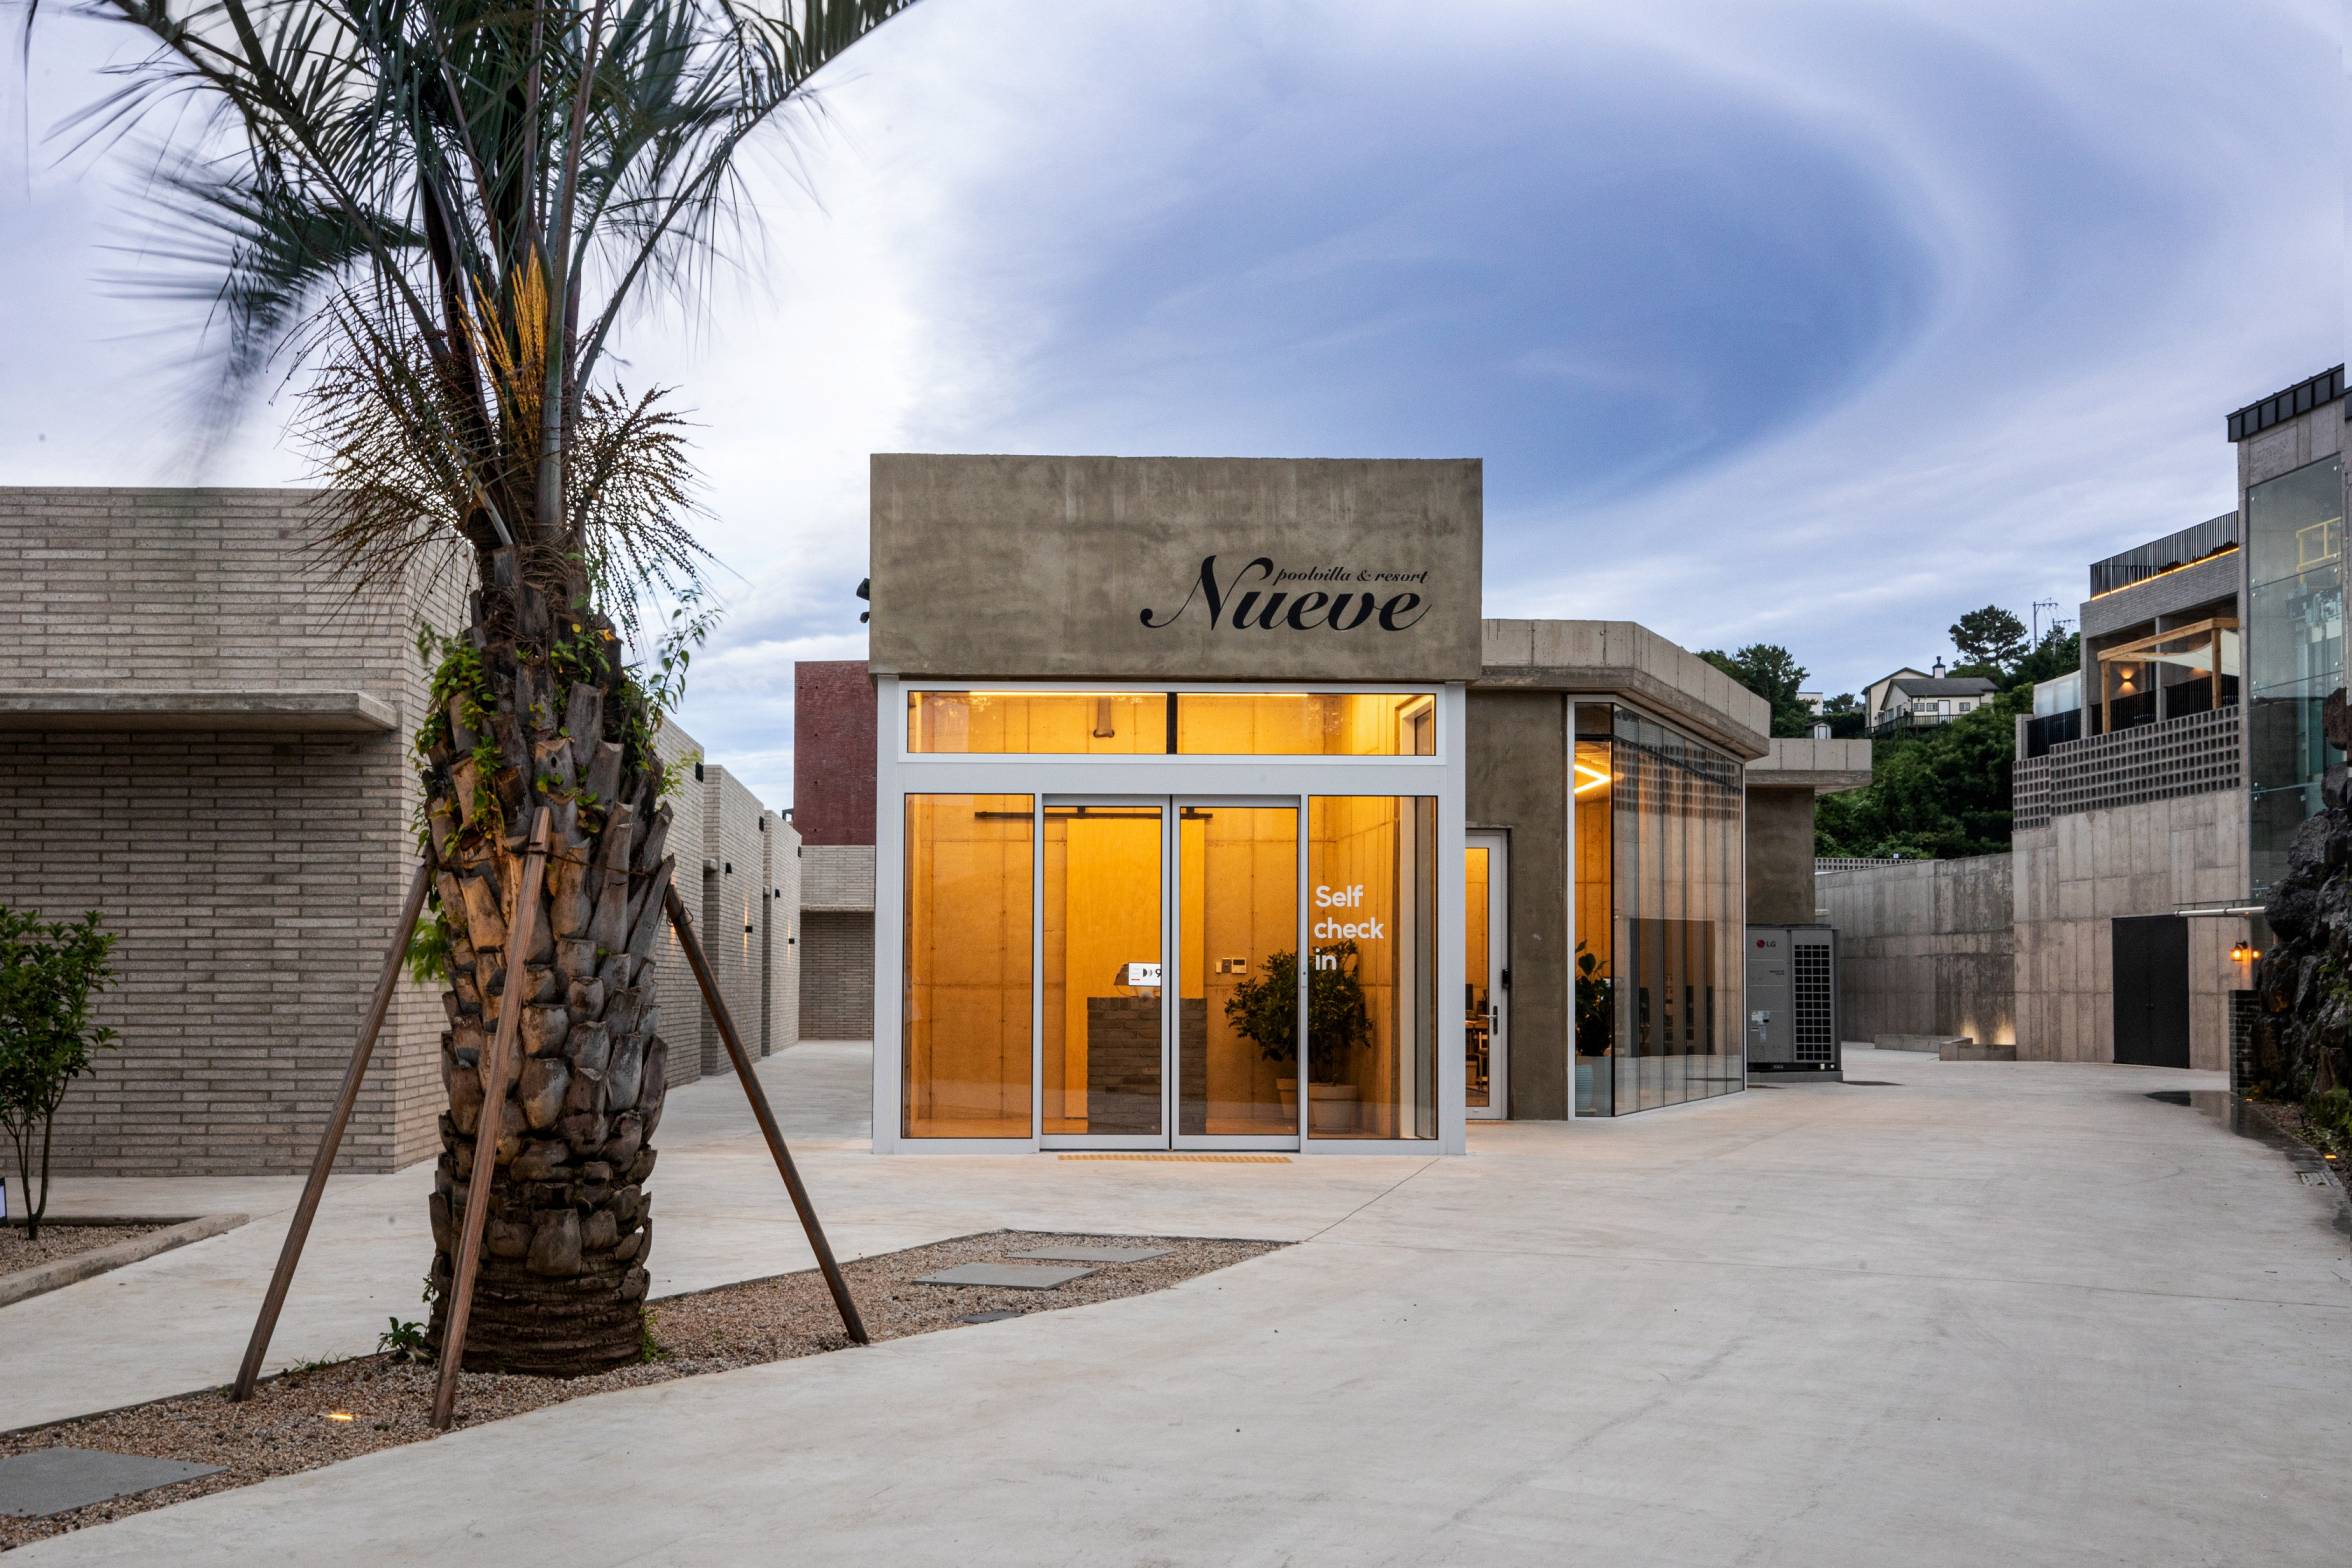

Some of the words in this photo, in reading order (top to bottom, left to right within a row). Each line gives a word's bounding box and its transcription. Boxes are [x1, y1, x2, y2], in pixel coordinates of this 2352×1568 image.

[1272, 566, 1351, 586] poolvilla
[1356, 569, 1372, 582] &
[1374, 570, 1429, 584] resort
[1139, 555, 1433, 632] Nueve
[1315, 884, 1364, 908] Self
[1314, 916, 1385, 939] check
[1315, 947, 1337, 971] in
